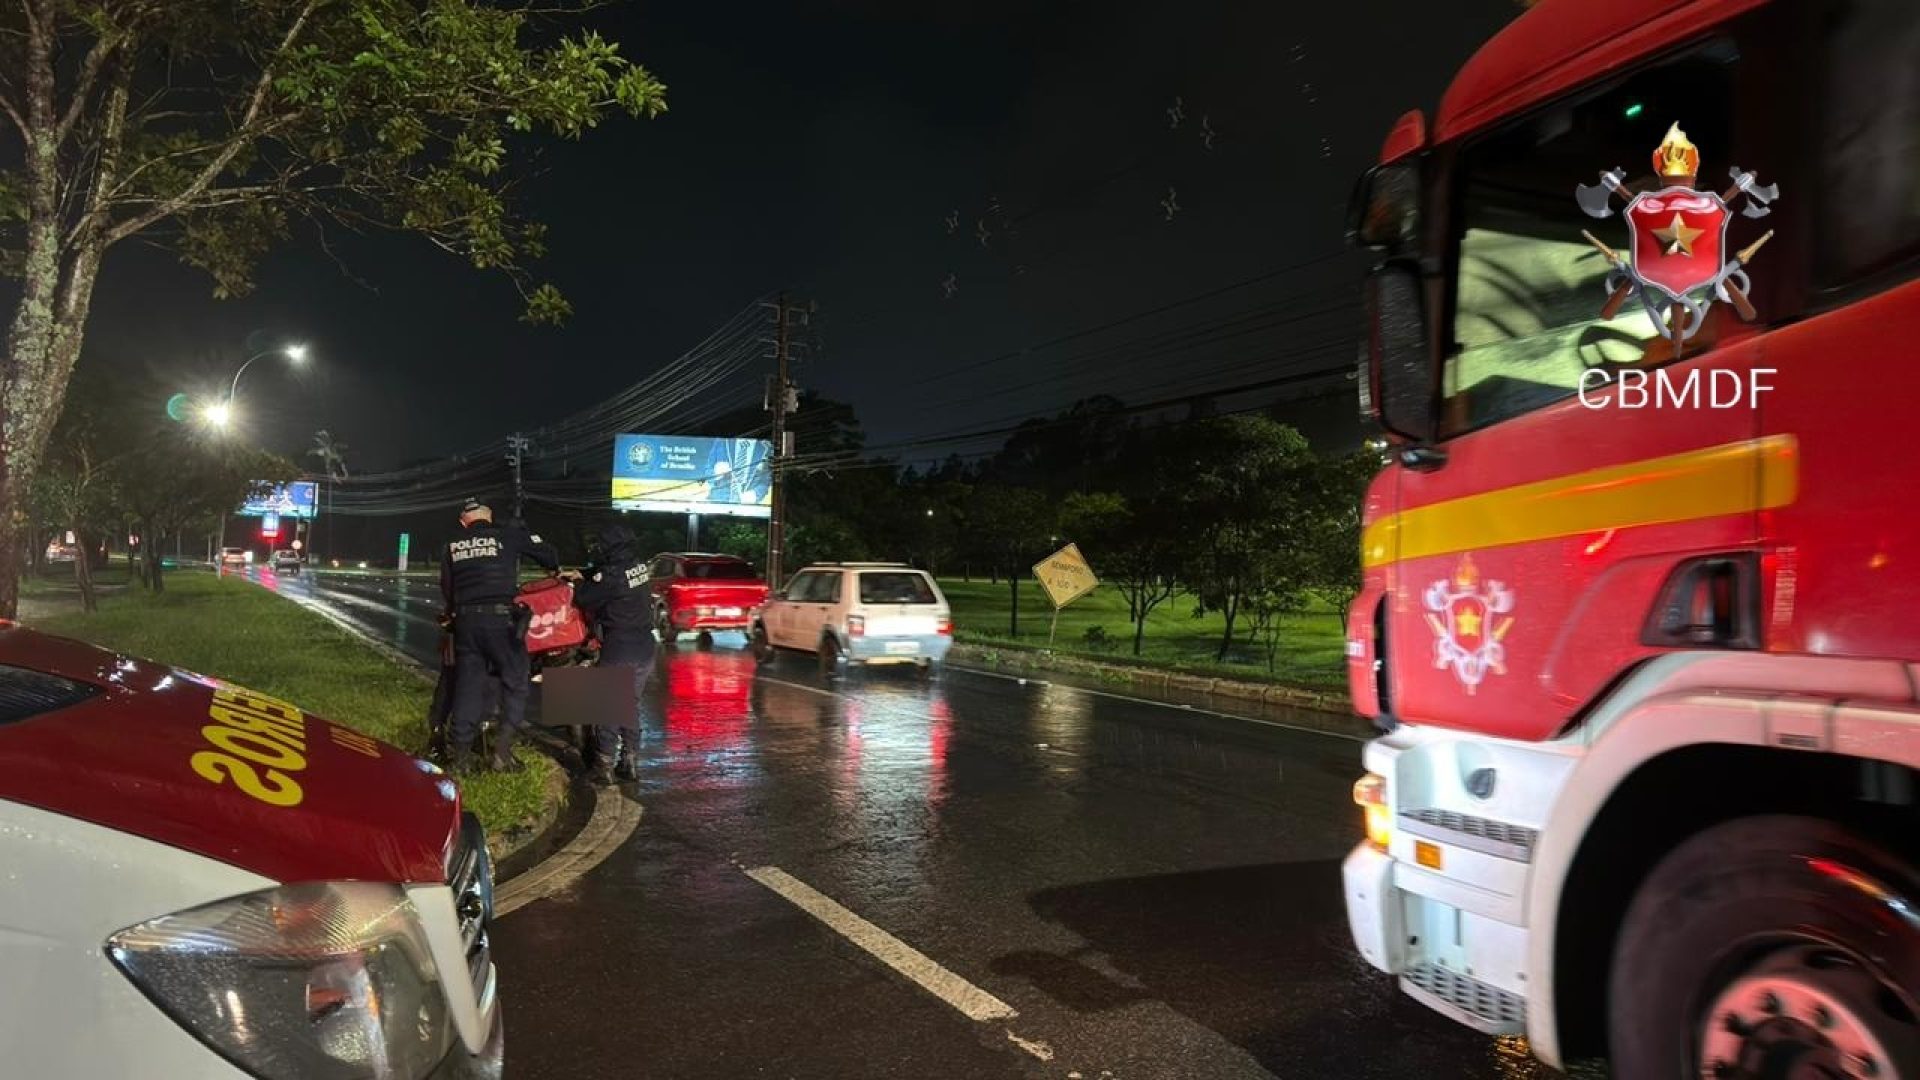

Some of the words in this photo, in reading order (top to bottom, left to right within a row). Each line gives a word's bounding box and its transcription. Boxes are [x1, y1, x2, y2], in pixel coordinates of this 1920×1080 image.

[660, 445, 673, 454] The
[674, 446, 697, 454] British
[450, 536, 497, 553] POLÍCIA
[452, 546, 498, 563] MILITAR
